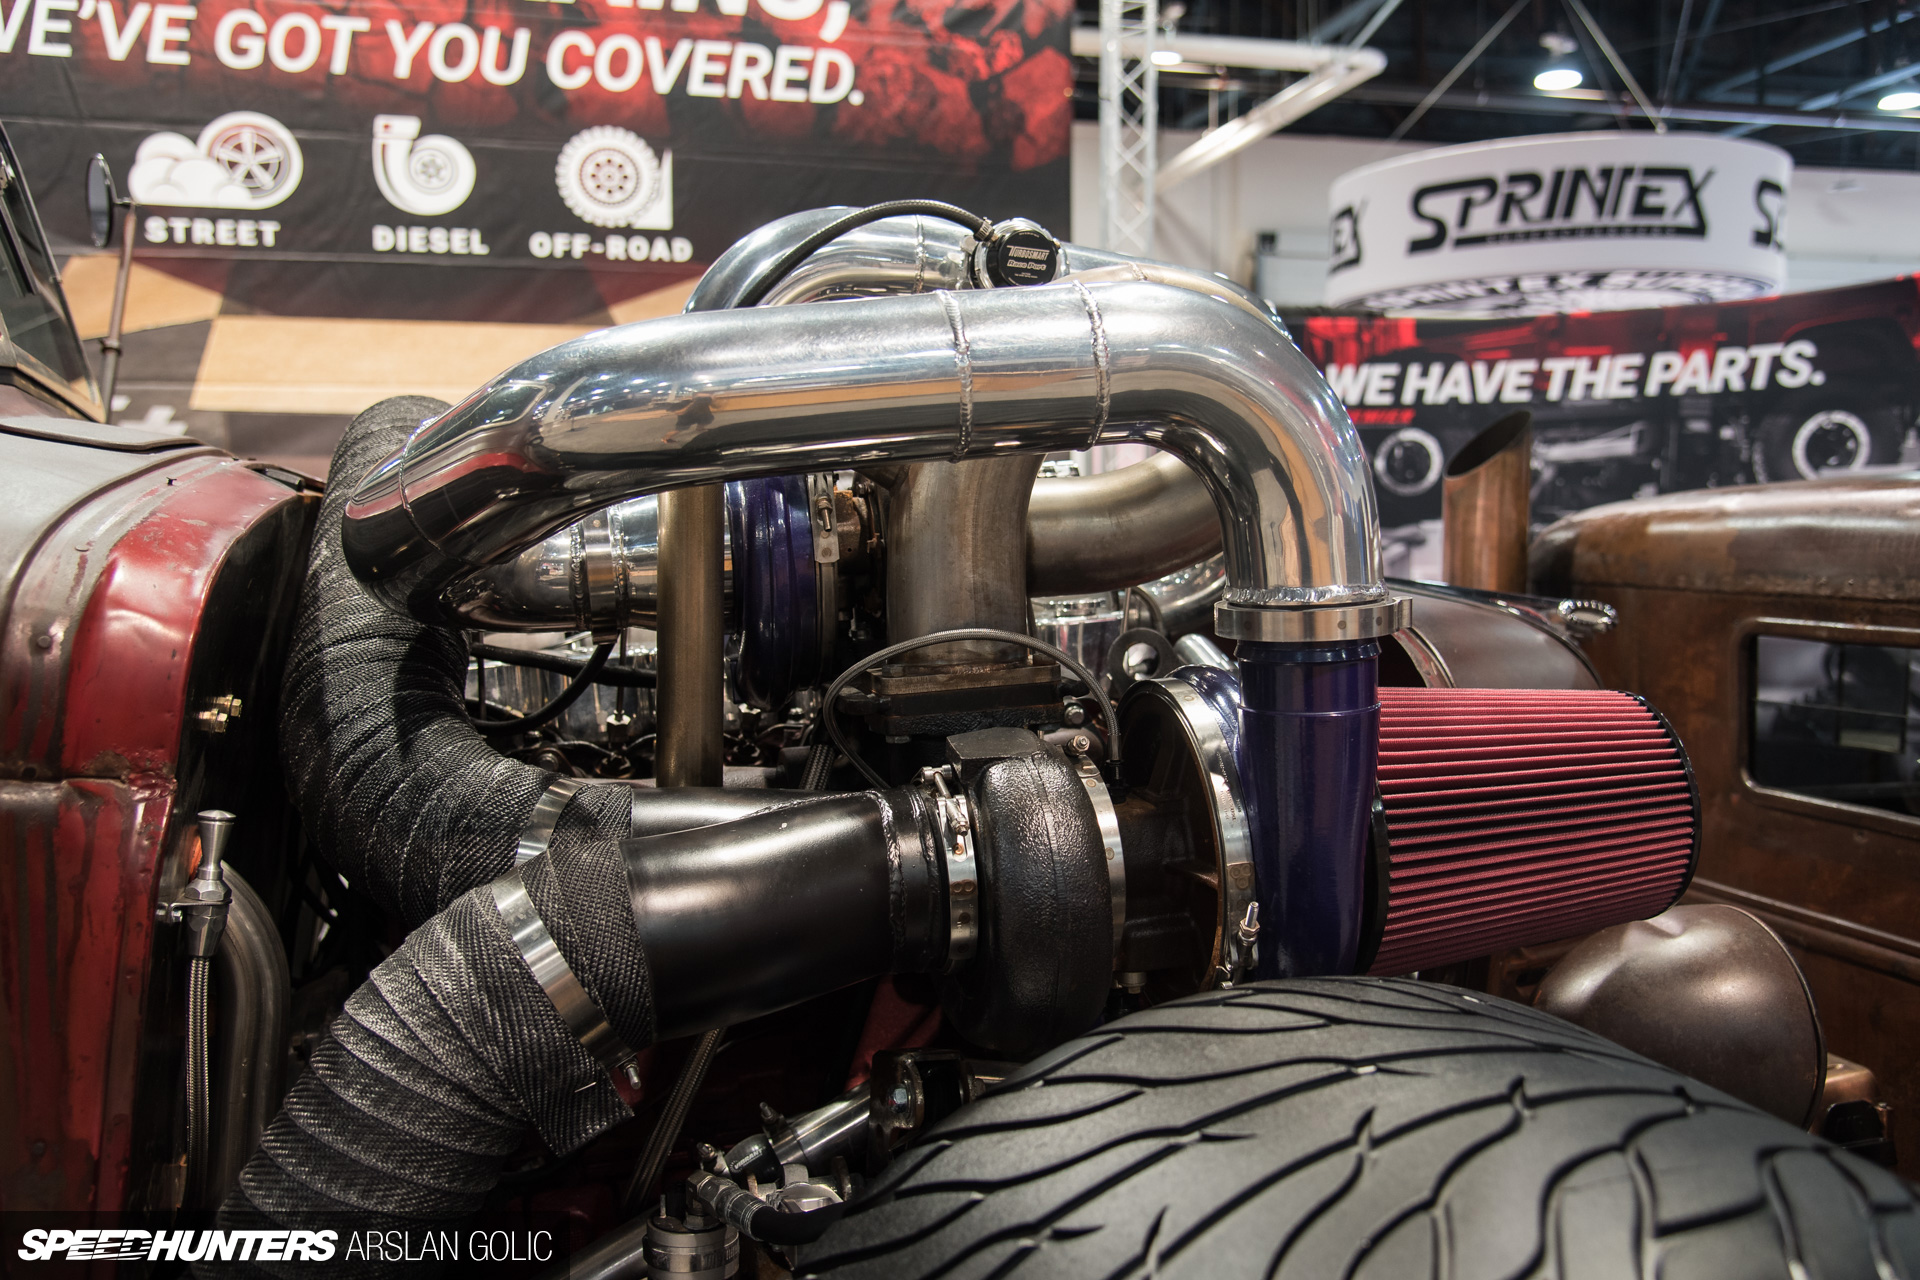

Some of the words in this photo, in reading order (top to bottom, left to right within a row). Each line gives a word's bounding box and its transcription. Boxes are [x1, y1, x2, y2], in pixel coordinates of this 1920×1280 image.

[214, 8, 370, 74] GOT
[385, 18, 531, 86] YOU
[546, 29, 865, 106] COVERED.
[1408, 166, 1713, 253] SPRINTEX
[145, 217, 280, 247] STREET
[372, 225, 489, 255] DIESEL
[529, 231, 693, 263] OFF-ROAD
[1006, 245, 1050, 261] TURBOSMART
[1325, 363, 1401, 406] WE
[1399, 360, 1539, 405] HAVE
[1541, 355, 1644, 402] THE
[1645, 341, 1826, 398] PARTS.
